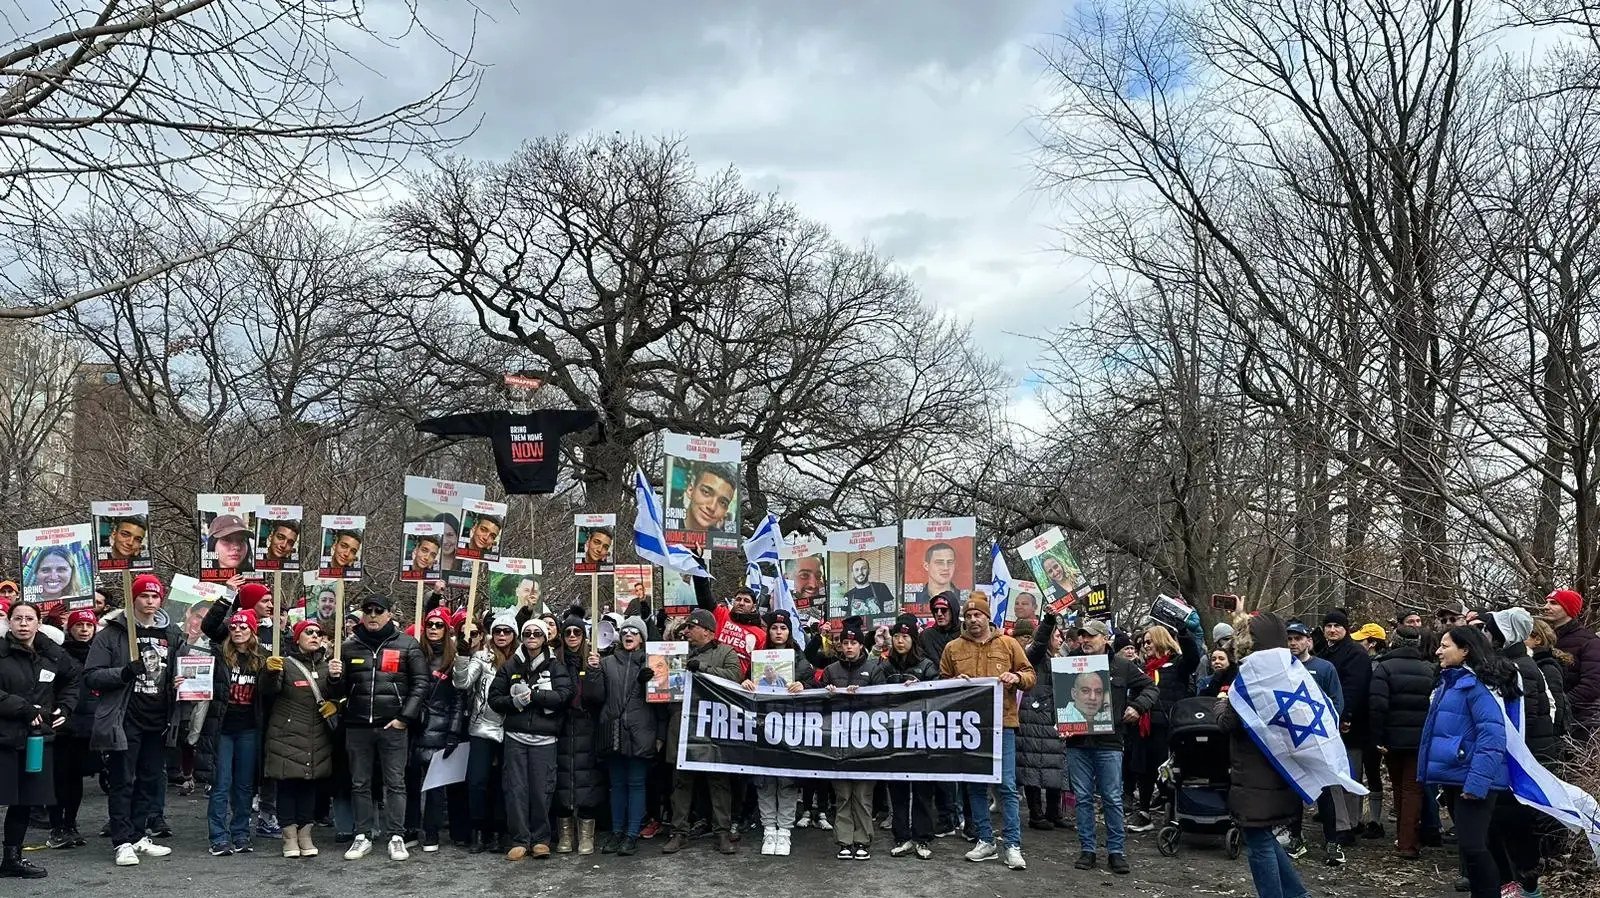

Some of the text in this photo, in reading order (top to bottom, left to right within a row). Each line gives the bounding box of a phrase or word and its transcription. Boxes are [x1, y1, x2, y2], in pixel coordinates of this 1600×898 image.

[510, 426, 527, 434] BRING
[511, 433, 543, 441] THEM HOME
[512, 442, 544, 459] NOW
[666, 507, 687, 519] BRING
[666, 518, 679, 530] HIM
[666, 530, 685, 542] HOME
[686, 532, 706, 544] NOW!
[201, 551, 219, 560] BRING
[201, 560, 213, 568] HER
[201, 569, 219, 578] HOME
[220, 568, 236, 578] NOW!
[23, 585, 43, 594] BRING
[23, 594, 37, 602] HER
[904, 592, 917, 603] HIM
[723, 621, 743, 633] RUN
[718, 633, 746, 649] LIVES
[696, 701, 982, 750] FREE OUR HOSTAGES
